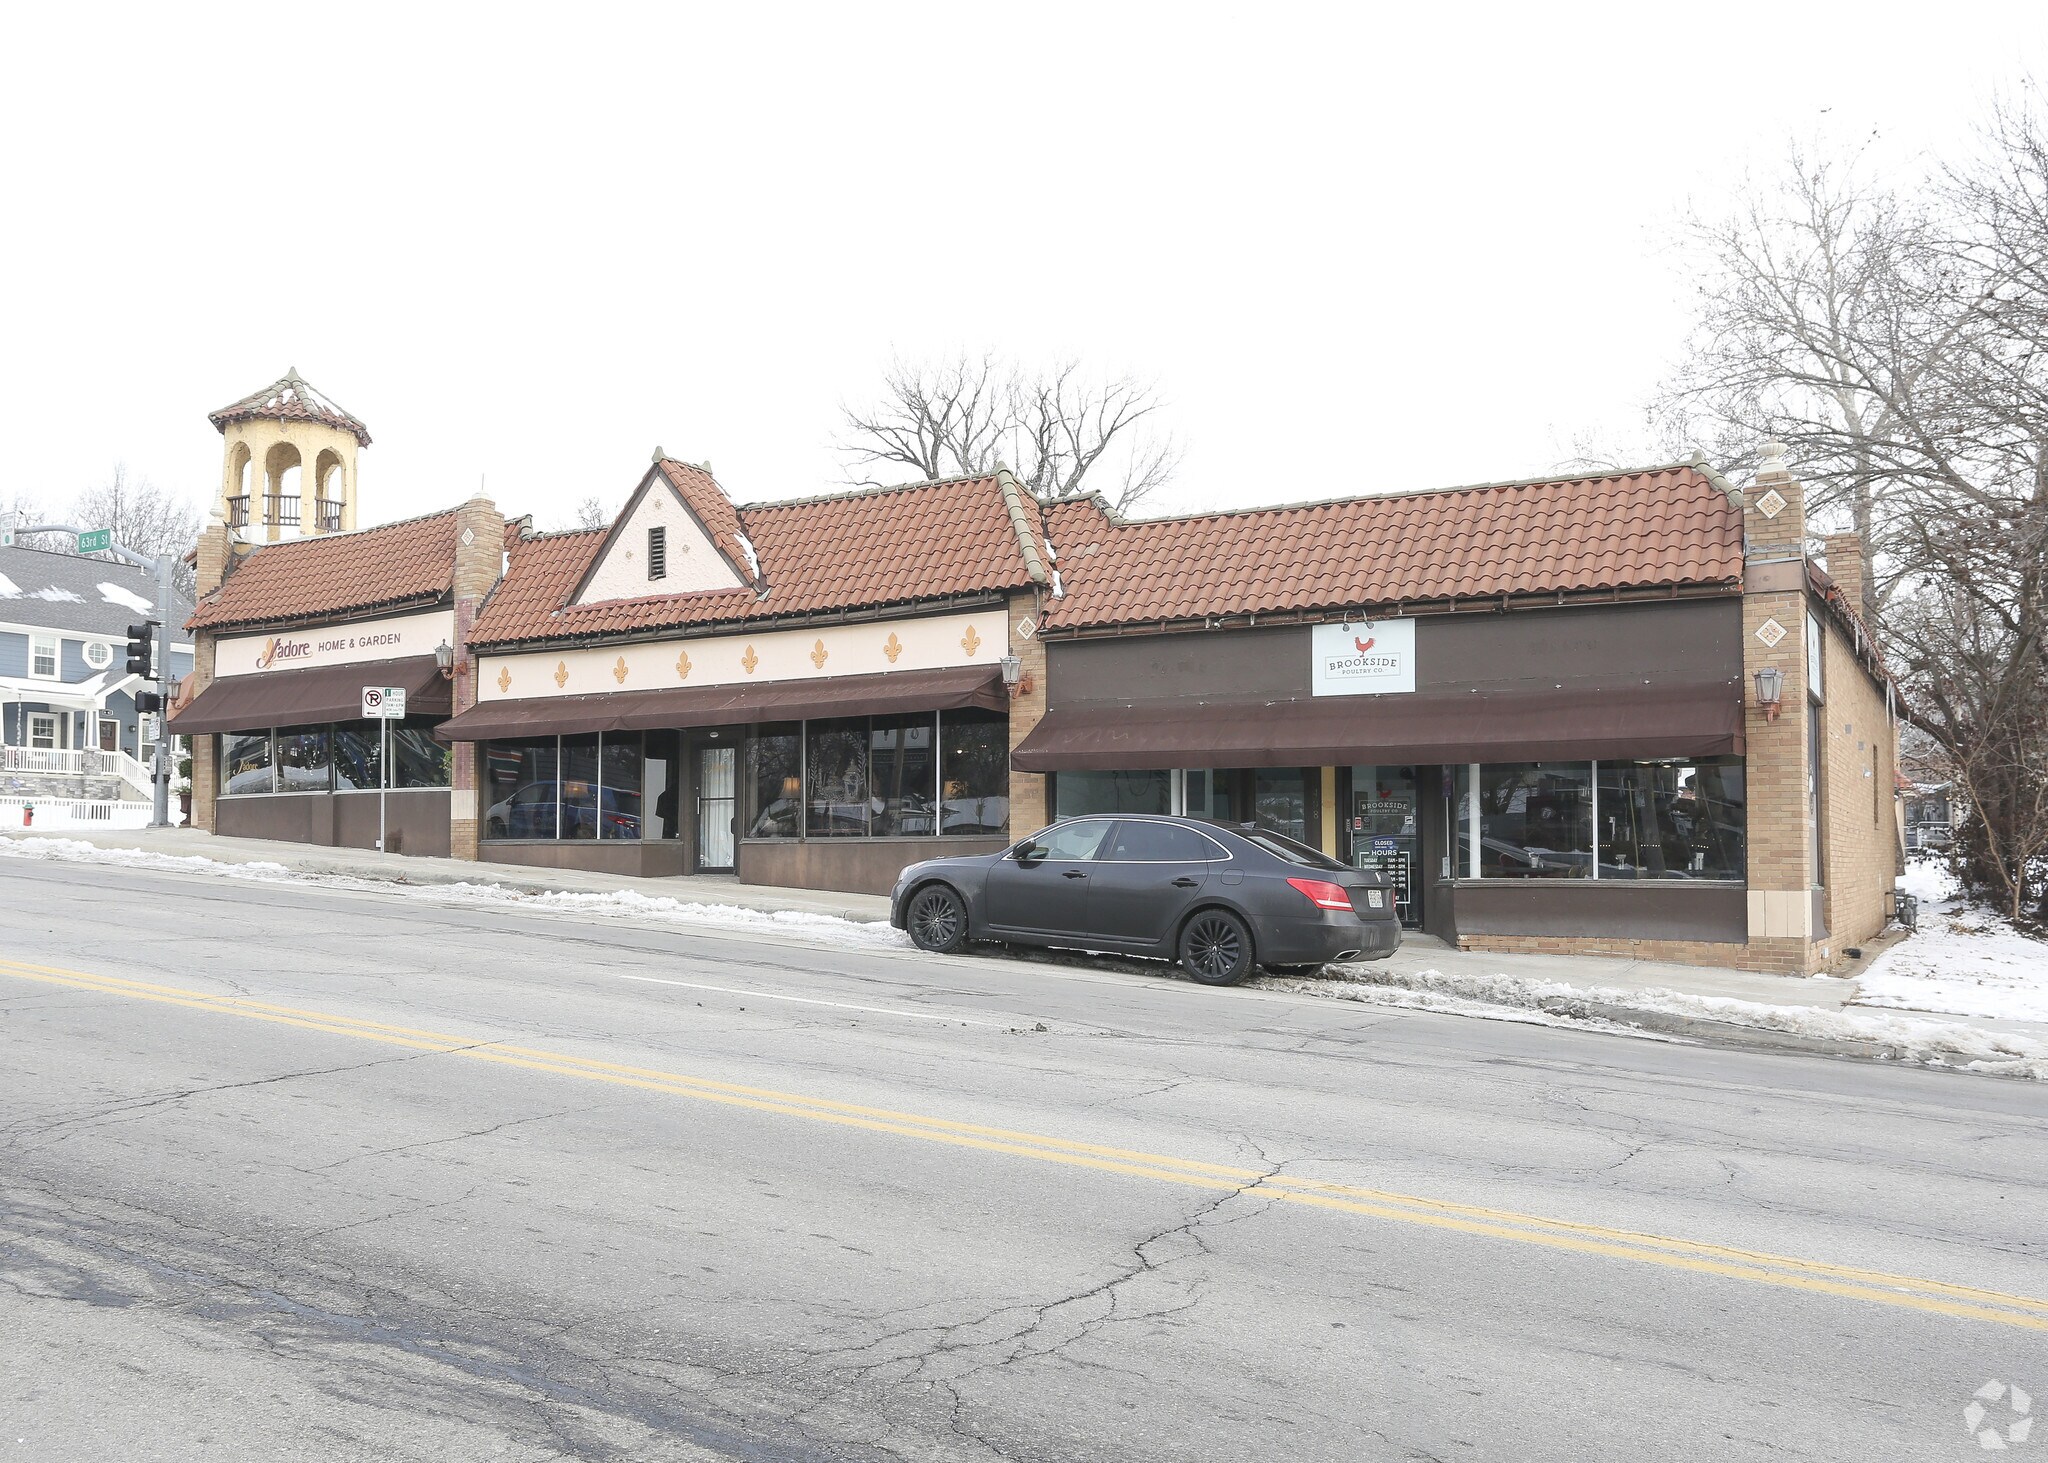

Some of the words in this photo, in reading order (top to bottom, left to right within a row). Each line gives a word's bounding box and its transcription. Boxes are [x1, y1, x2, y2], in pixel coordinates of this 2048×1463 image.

[81, 535, 96, 548] 63rd
[101, 534, 108, 545] St
[318, 639, 345, 652] HOME
[349, 638, 355, 649] &
[359, 633, 401, 647] GARDEN
[1329, 657, 1397, 671] BROOKSIDE
[1361, 801, 1408, 810] BROOKSIDE
